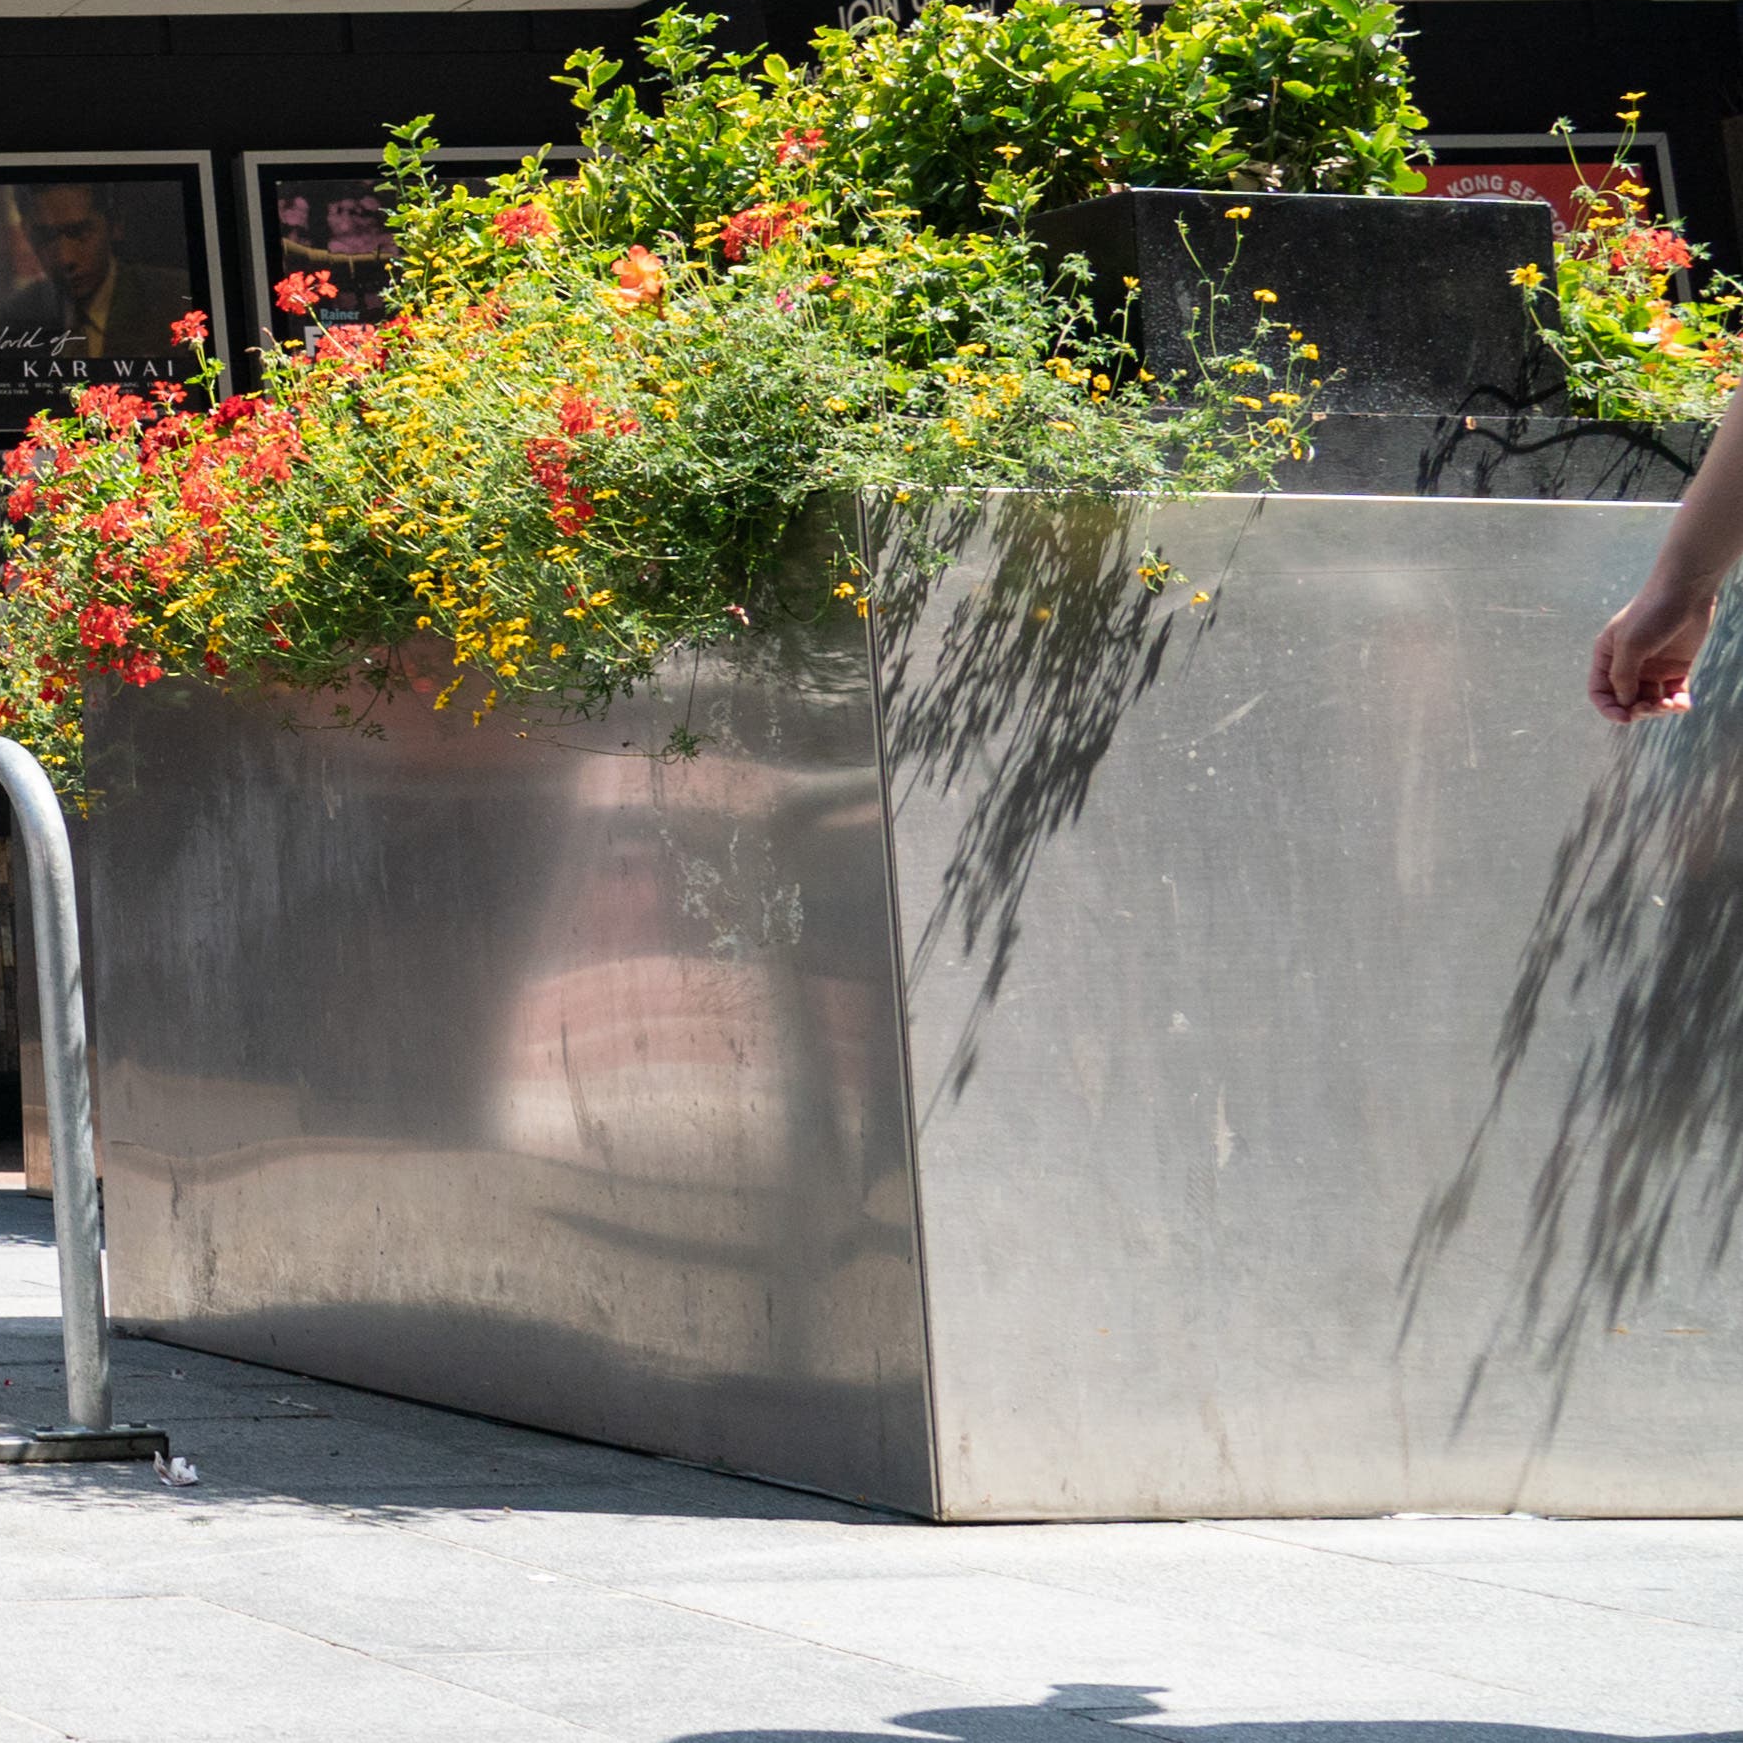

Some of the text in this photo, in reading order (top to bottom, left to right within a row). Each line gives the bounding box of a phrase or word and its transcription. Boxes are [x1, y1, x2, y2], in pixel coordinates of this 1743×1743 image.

[1446, 174, 1504, 198] KONG
[320, 308, 361, 320] Rainer
[49, 328, 87, 357] of
[23, 359, 89, 378] KAR
[112, 359, 175, 377] WAI
